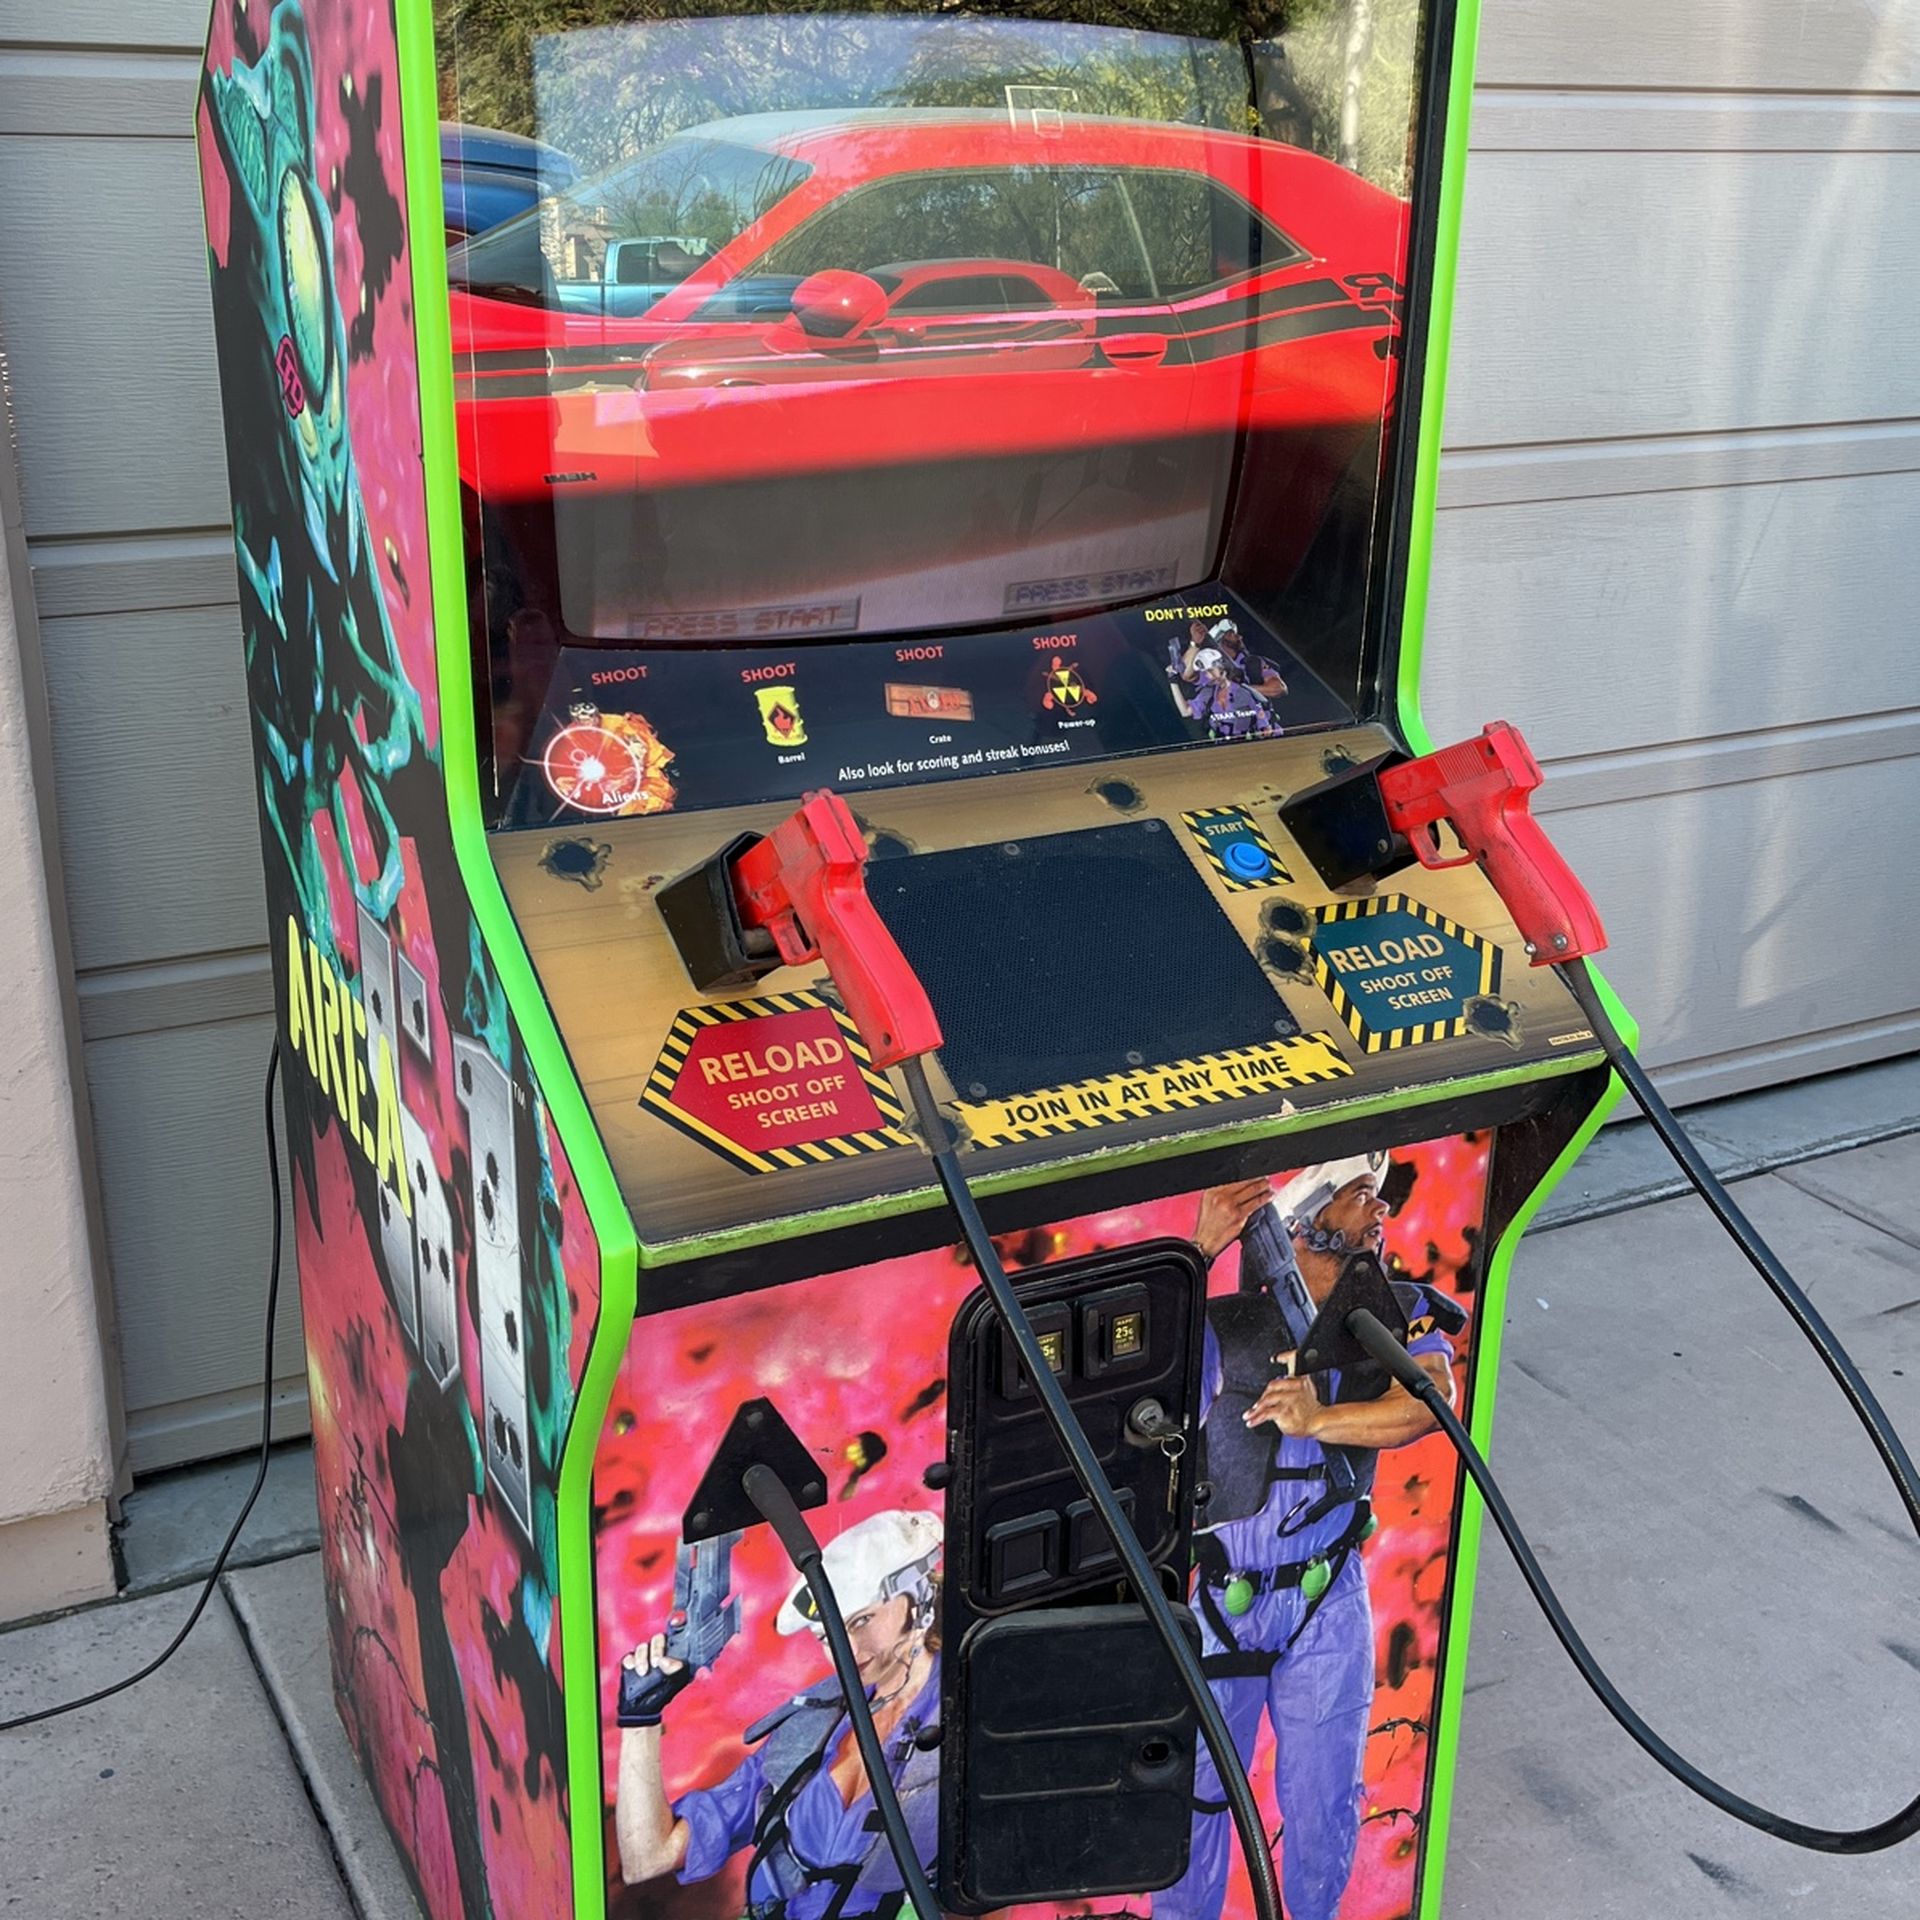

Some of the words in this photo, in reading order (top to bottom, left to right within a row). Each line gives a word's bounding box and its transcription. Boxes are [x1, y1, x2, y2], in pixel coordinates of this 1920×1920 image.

[1015, 578, 1090, 603] PRESS
[1101, 567, 1170, 594] START
[643, 613, 738, 638] PRESS
[753, 606, 852, 632] START
[1144, 607, 1184, 622] DON'T
[1186, 604, 1229, 619] SHOOT
[895, 645, 945, 663] SHOOT
[1032, 634, 1078, 650] SHOOT
[591, 665, 649, 686] SHOOT
[740, 662, 797, 684] SHOOT
[928, 734, 953, 745] Crate
[777, 751, 806, 765] Barrel
[838, 766, 866, 781] Also
[867, 761, 895, 778] look
[896, 759, 914, 774] for
[916, 755, 960, 771] scoring
[961, 750, 983, 765] and
[985, 745, 1019, 762] streak
[1020, 739, 1071, 757] bonuses!
[601, 789, 650, 806] Aliens
[1204, 821, 1244, 836] START
[1327, 933, 1445, 974] RELOAD
[1360, 971, 1419, 994] SHOOT
[1420, 965, 1454, 982] OFF
[1387, 987, 1455, 1010] SCREEN
[288, 914, 412, 1218] AREA
[698, 1037, 844, 1086] RELOAD
[727, 1083, 800, 1110] SHOOT
[806, 1075, 846, 1095] OFF
[1003, 1097, 1072, 1127] JOIN
[1077, 1091, 1111, 1112] IN
[1120, 1081, 1151, 1104] AT
[1162, 1069, 1214, 1096] ANY
[1220, 1055, 1291, 1083] TIME
[756, 1100, 839, 1129] SCREEN
